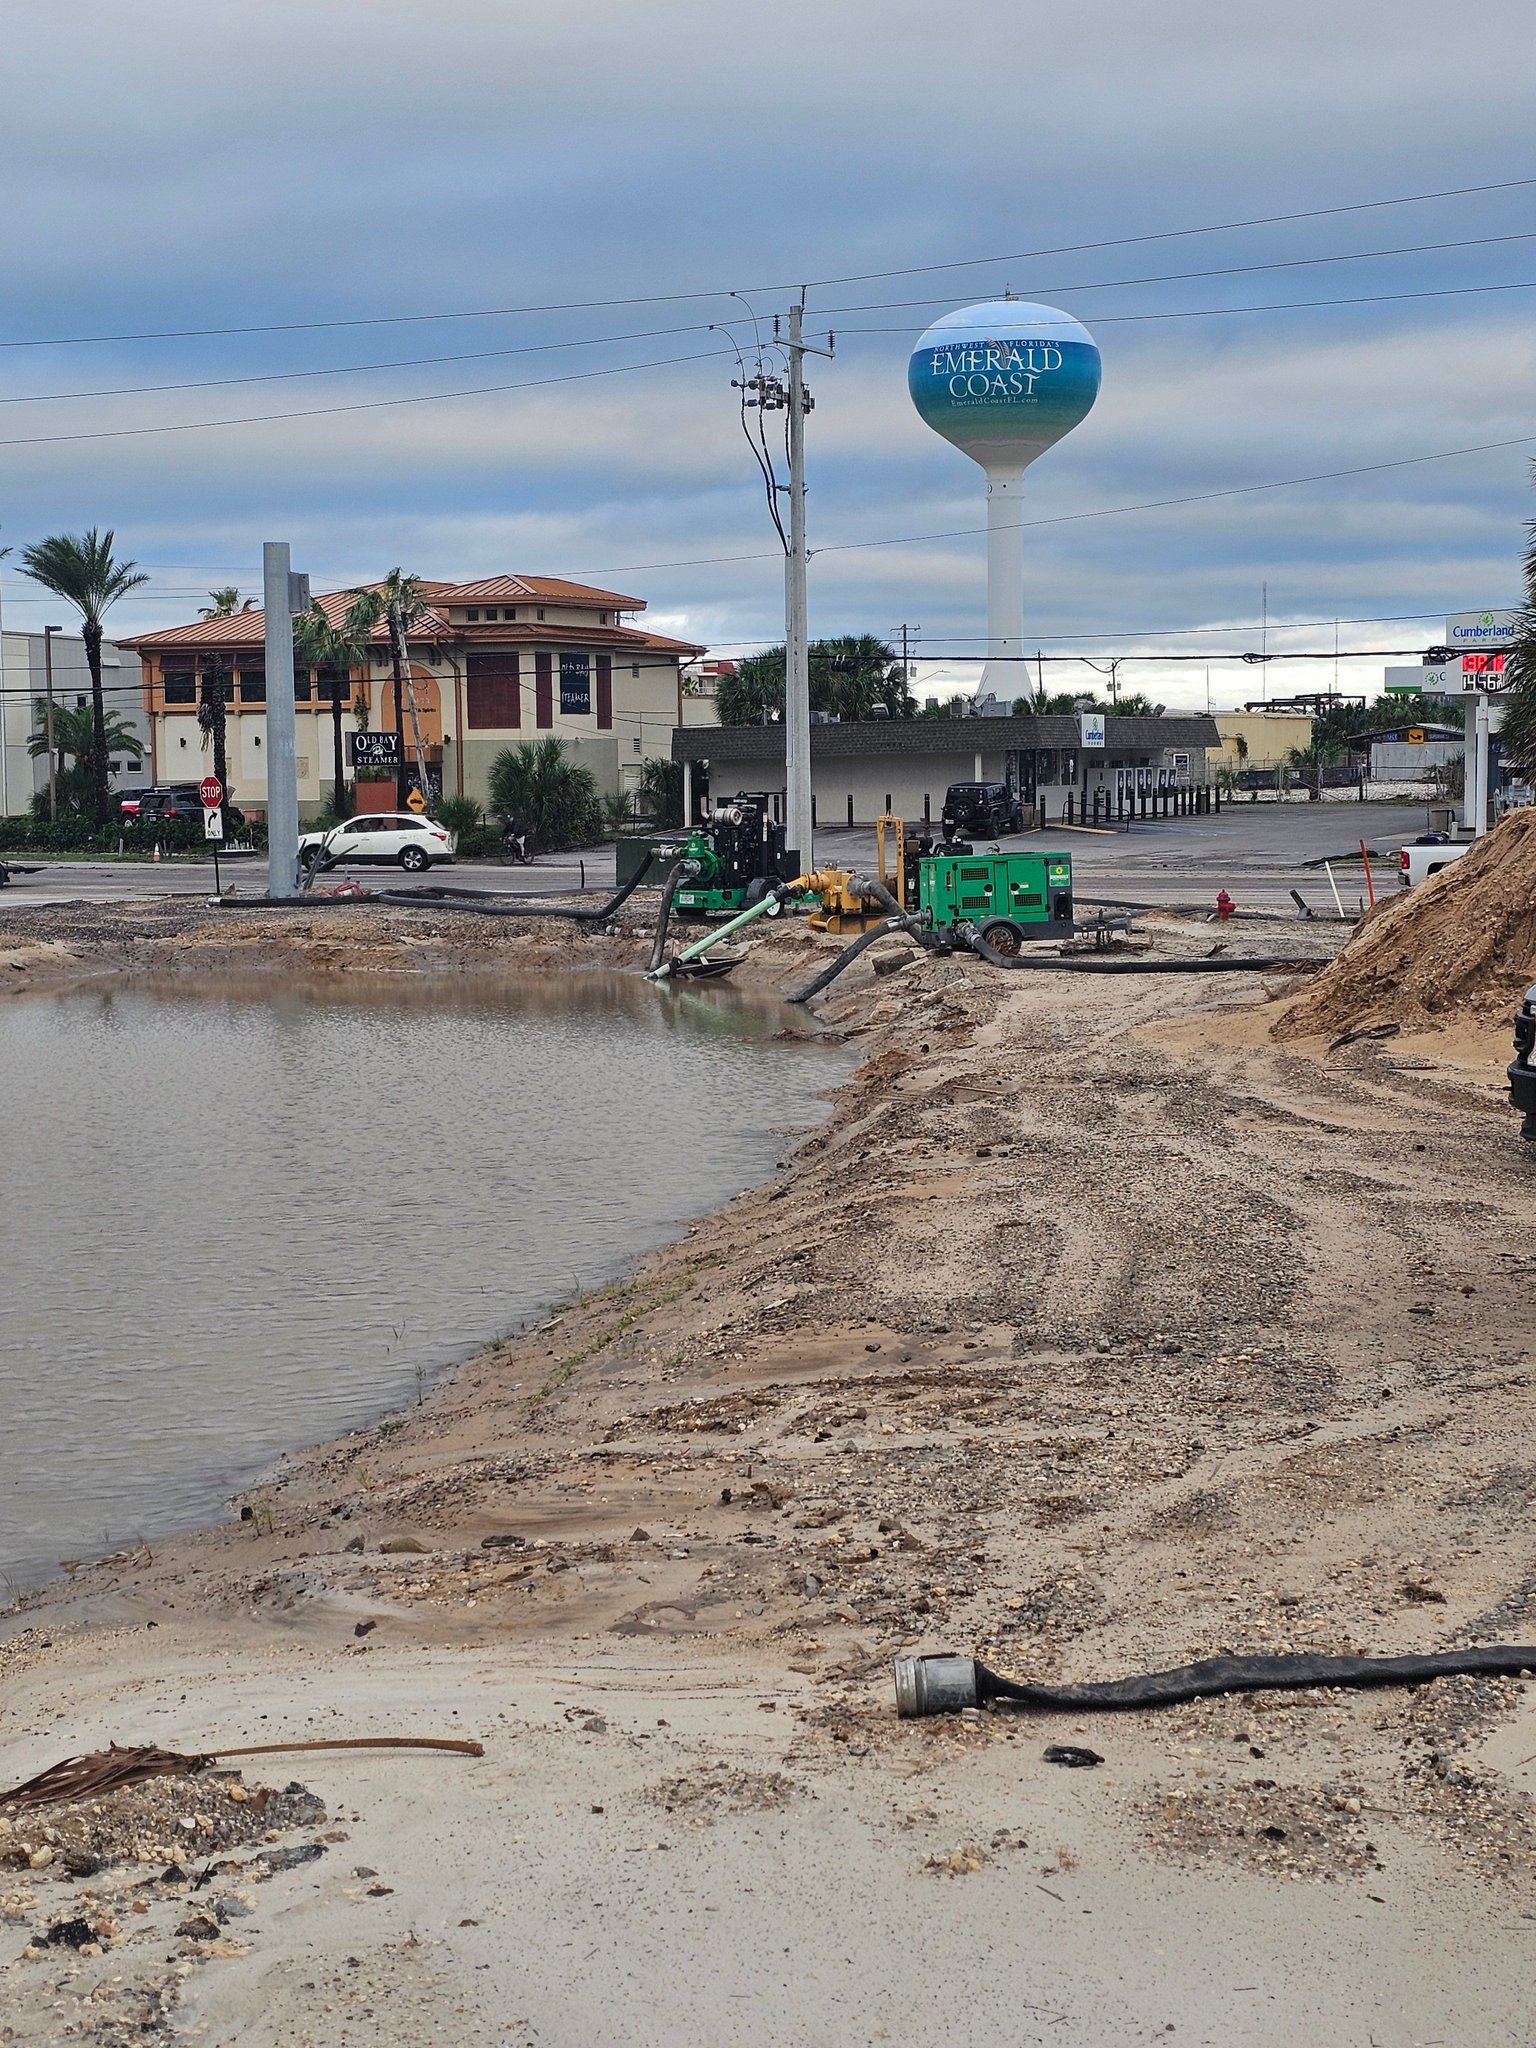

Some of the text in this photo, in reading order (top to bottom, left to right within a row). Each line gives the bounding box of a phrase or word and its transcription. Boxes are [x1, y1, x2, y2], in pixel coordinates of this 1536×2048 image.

[934, 340, 1060, 353] NORTHWEST FLORIDA'S
[930, 348, 1063, 376] EMERALD
[949, 372, 1040, 398] COAST
[951, 397, 1038, 407] EmeraldCoastFL.com
[1453, 625, 1515, 637] Cumberland
[356, 735, 398, 751] OLD BAY
[357, 756, 398, 764] STEAMER
[202, 786, 221, 798] STOP
